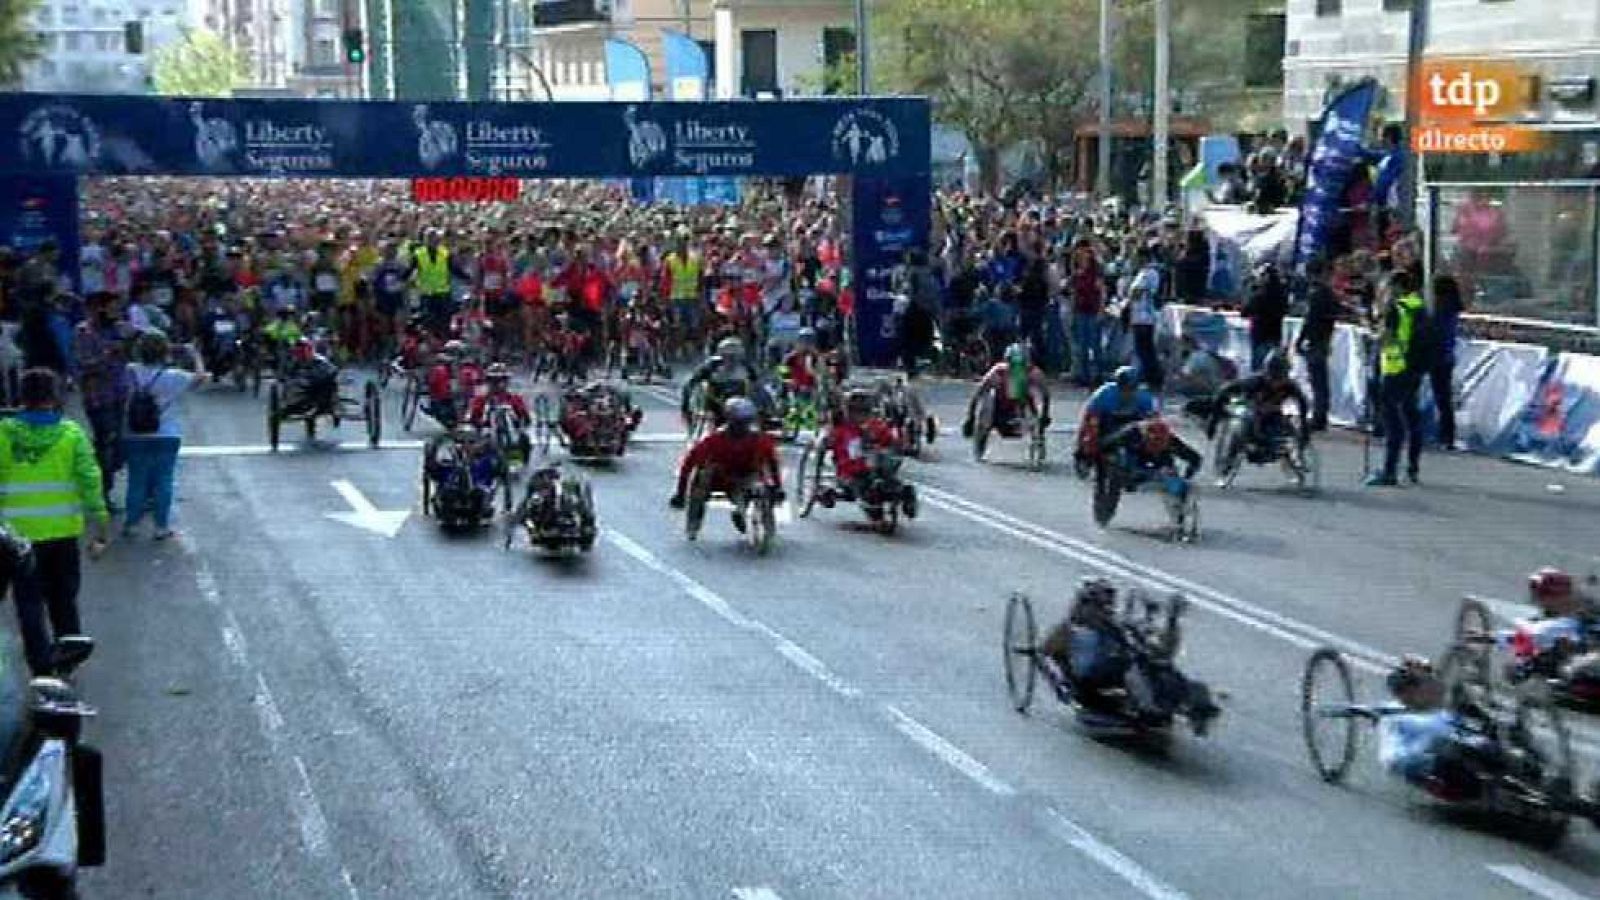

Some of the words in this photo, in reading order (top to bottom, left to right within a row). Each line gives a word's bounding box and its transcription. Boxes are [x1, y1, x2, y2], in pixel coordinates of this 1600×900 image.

[246, 120, 326, 151] Liberty
[466, 120, 542, 150] Liberty
[675, 120, 750, 146] Liberty
[247, 149, 333, 179] Seguros
[465, 149, 548, 176] Seguros
[675, 149, 754, 174] Seguros
